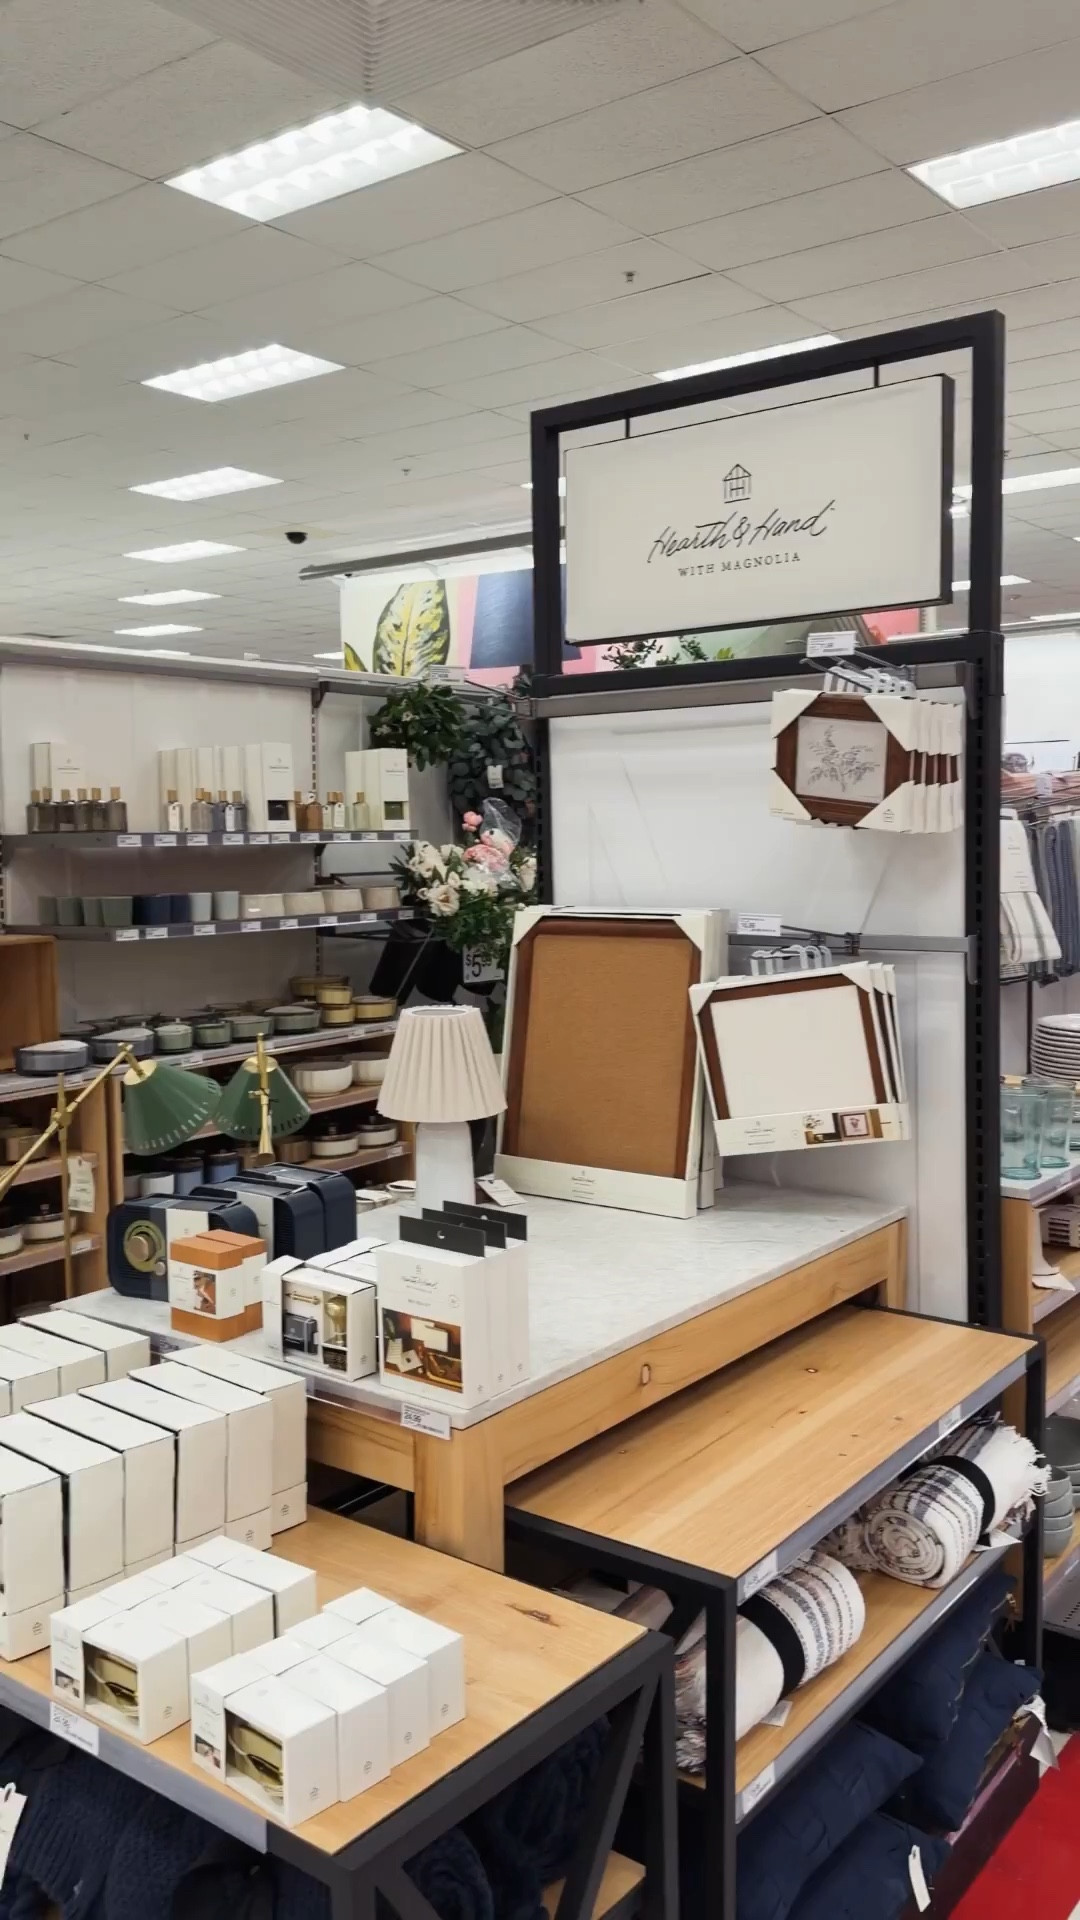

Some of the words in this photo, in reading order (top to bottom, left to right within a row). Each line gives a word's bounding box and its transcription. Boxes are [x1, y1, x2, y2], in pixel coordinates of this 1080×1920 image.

[647, 511, 737, 563] Hearth
[732, 516, 751, 548] &
[748, 499, 836, 546] Hand
[678, 563, 715, 577] WITH
[721, 552, 801, 572] MAGNOLIA
